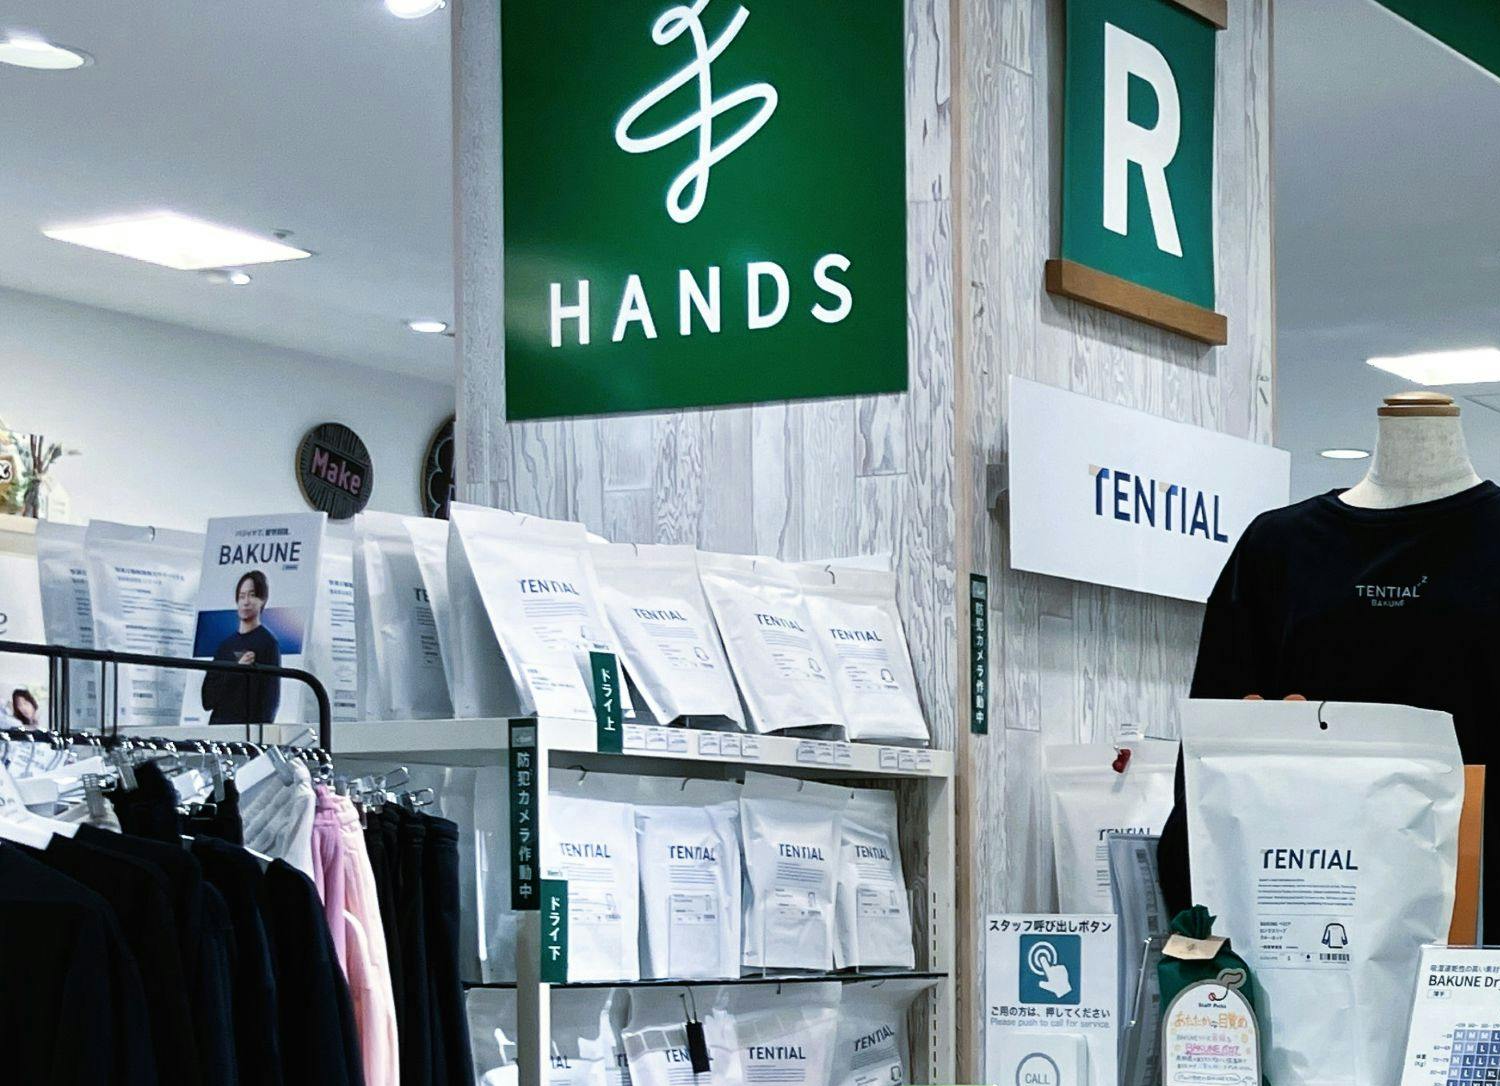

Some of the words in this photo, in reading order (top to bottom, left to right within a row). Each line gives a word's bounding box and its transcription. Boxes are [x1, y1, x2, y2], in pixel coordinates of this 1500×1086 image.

[1103, 21, 1182, 258] R
[549, 252, 855, 348] HANDS
[310, 447, 362, 495] Make
[1089, 463, 1229, 543] TENTIAL
[219, 541, 301, 565] BAKUNE
[517, 578, 580, 596] TENTIAL
[1355, 585, 1420, 598] TENTIAL
[633, 607, 688, 622] TENTIAL
[753, 612, 805, 633] TENTIAL
[828, 626, 882, 643] TENTIAL
[516, 752, 533, 900] 防犯カメラ作動中
[559, 842, 611, 859] TENTIAL
[668, 845, 716, 862] TENTIAL
[779, 842, 825, 862] TENTIAL
[855, 845, 891, 863] TENTIAL
[1260, 848, 1359, 871] TENTIAL
[988, 917, 1112, 934] スタッフ呼び出しボタン
[1428, 974, 1481, 988] BAKUNE
[853, 1024, 895, 1053] TENTIAL
[748, 1045, 806, 1061] TENTIAL
[1024, 1072, 1051, 1084] CALL
